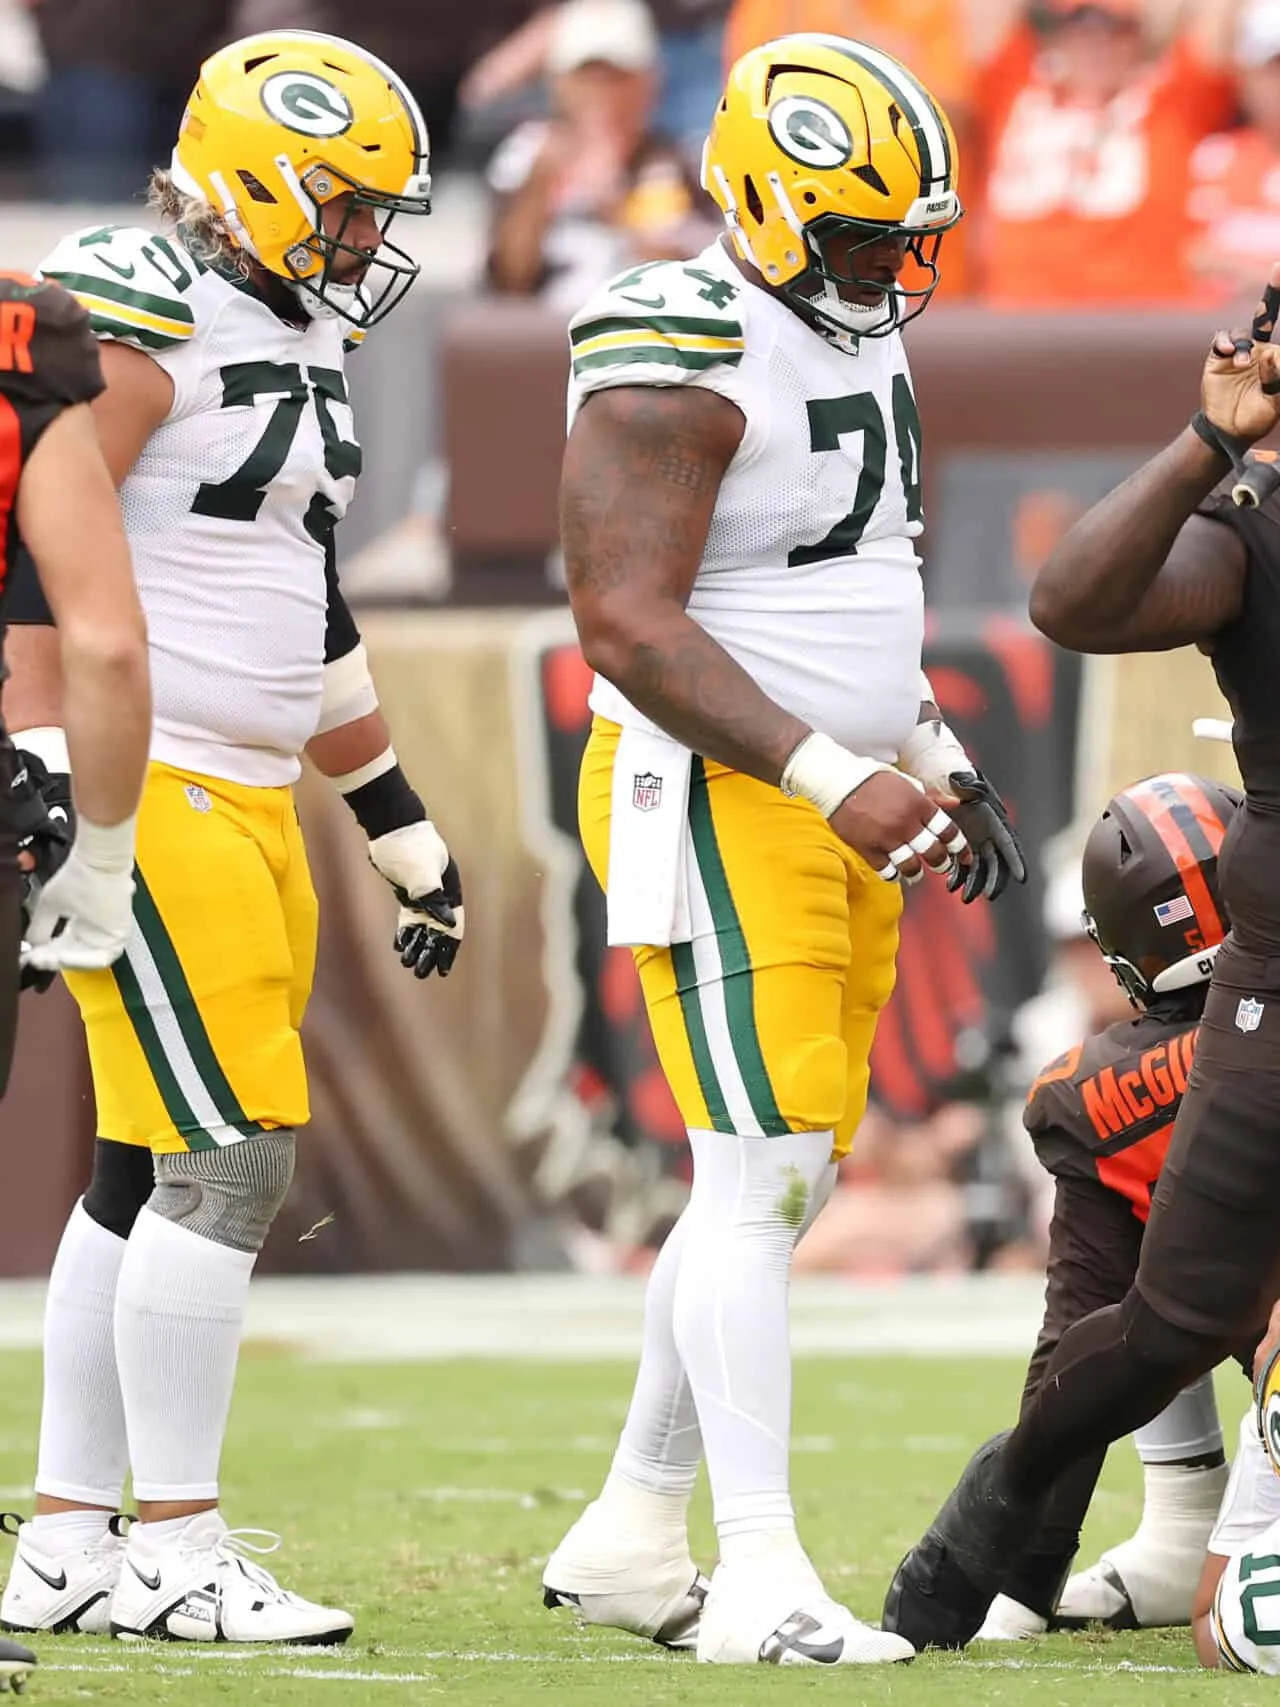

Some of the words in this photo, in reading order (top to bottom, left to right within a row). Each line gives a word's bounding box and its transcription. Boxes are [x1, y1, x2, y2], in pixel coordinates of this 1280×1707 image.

[260, 70, 354, 138] G
[767, 94, 852, 169] G
[190, 361, 362, 540] 75
[1082, 1027, 1200, 1140] McGU
